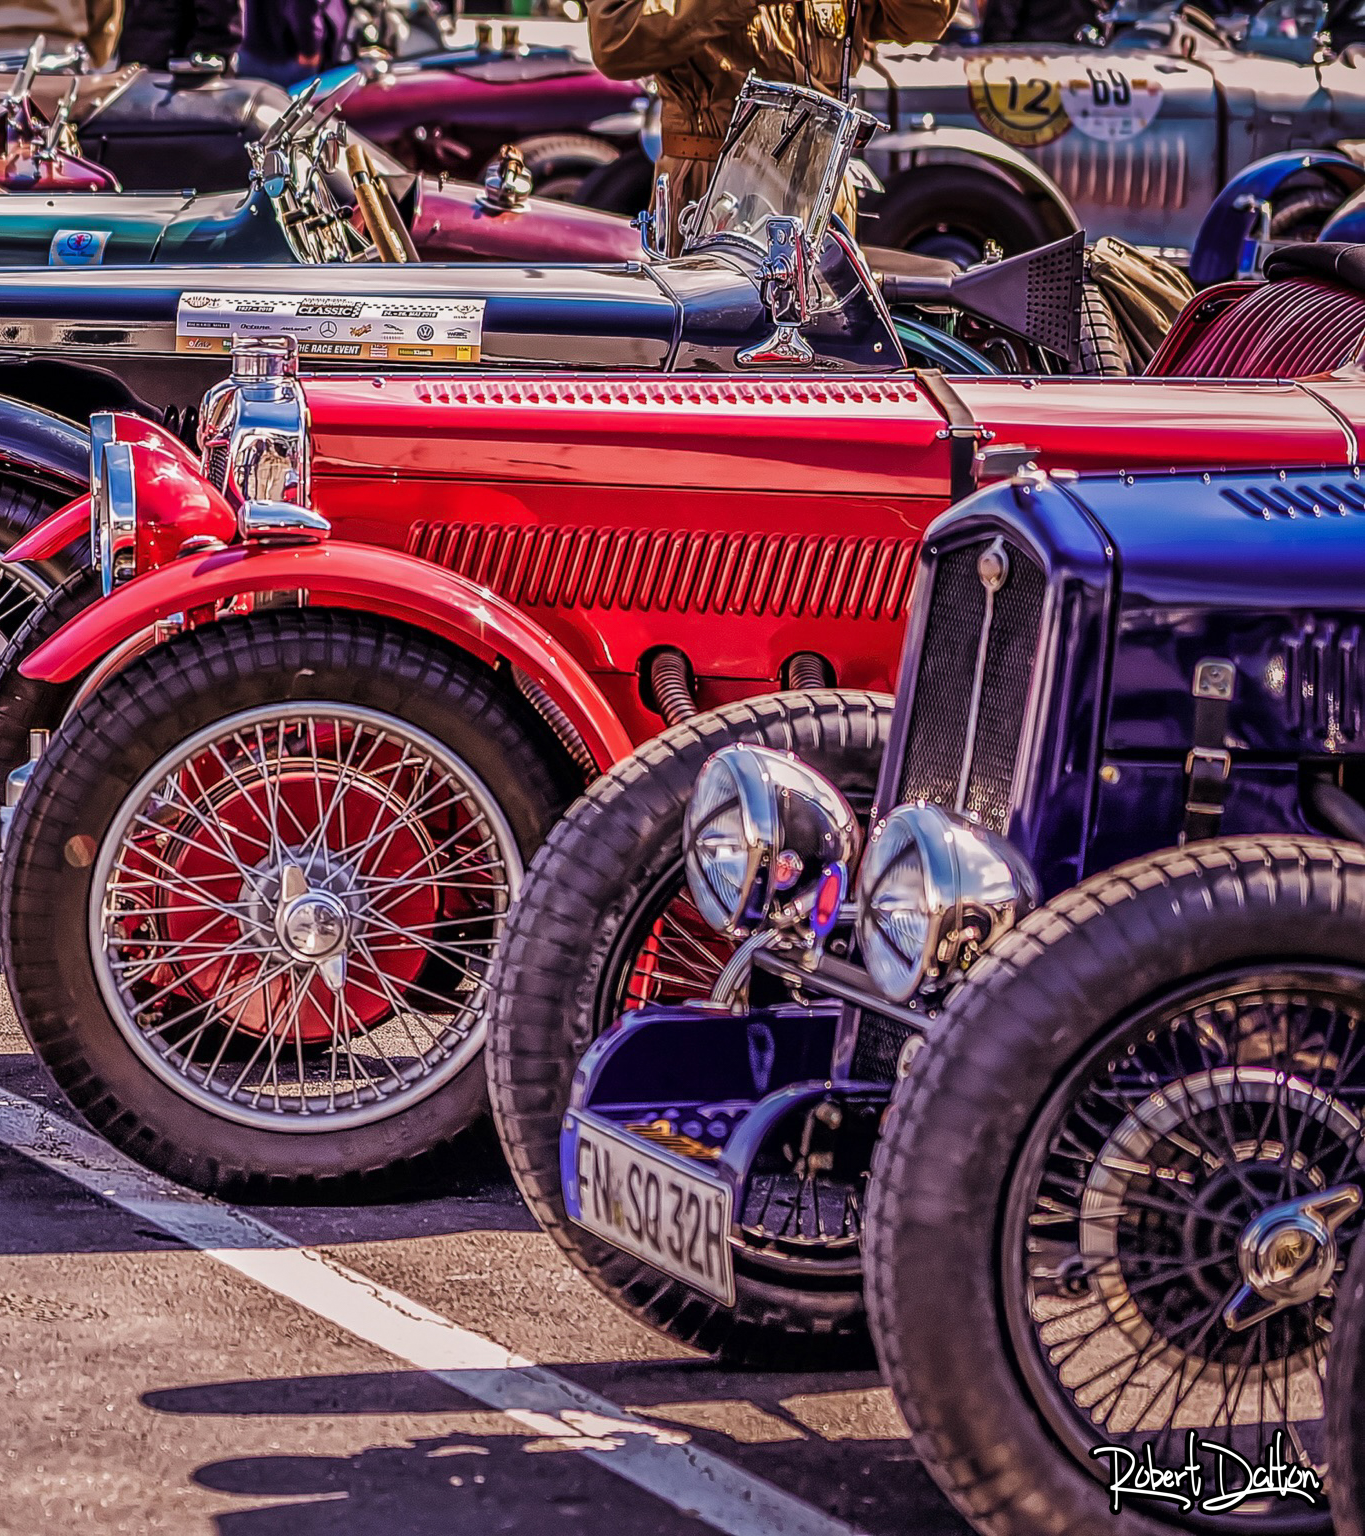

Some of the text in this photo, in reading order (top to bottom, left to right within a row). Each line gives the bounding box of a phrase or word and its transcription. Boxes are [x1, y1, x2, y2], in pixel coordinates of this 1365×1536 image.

[1008, 77, 1051, 115] 12
[1087, 69, 1131, 107] 69
[298, 306, 351, 315] CLASSIC
[296, 344, 360, 354] THE RACE EVENT
[667, 1182, 727, 1287] 32H
